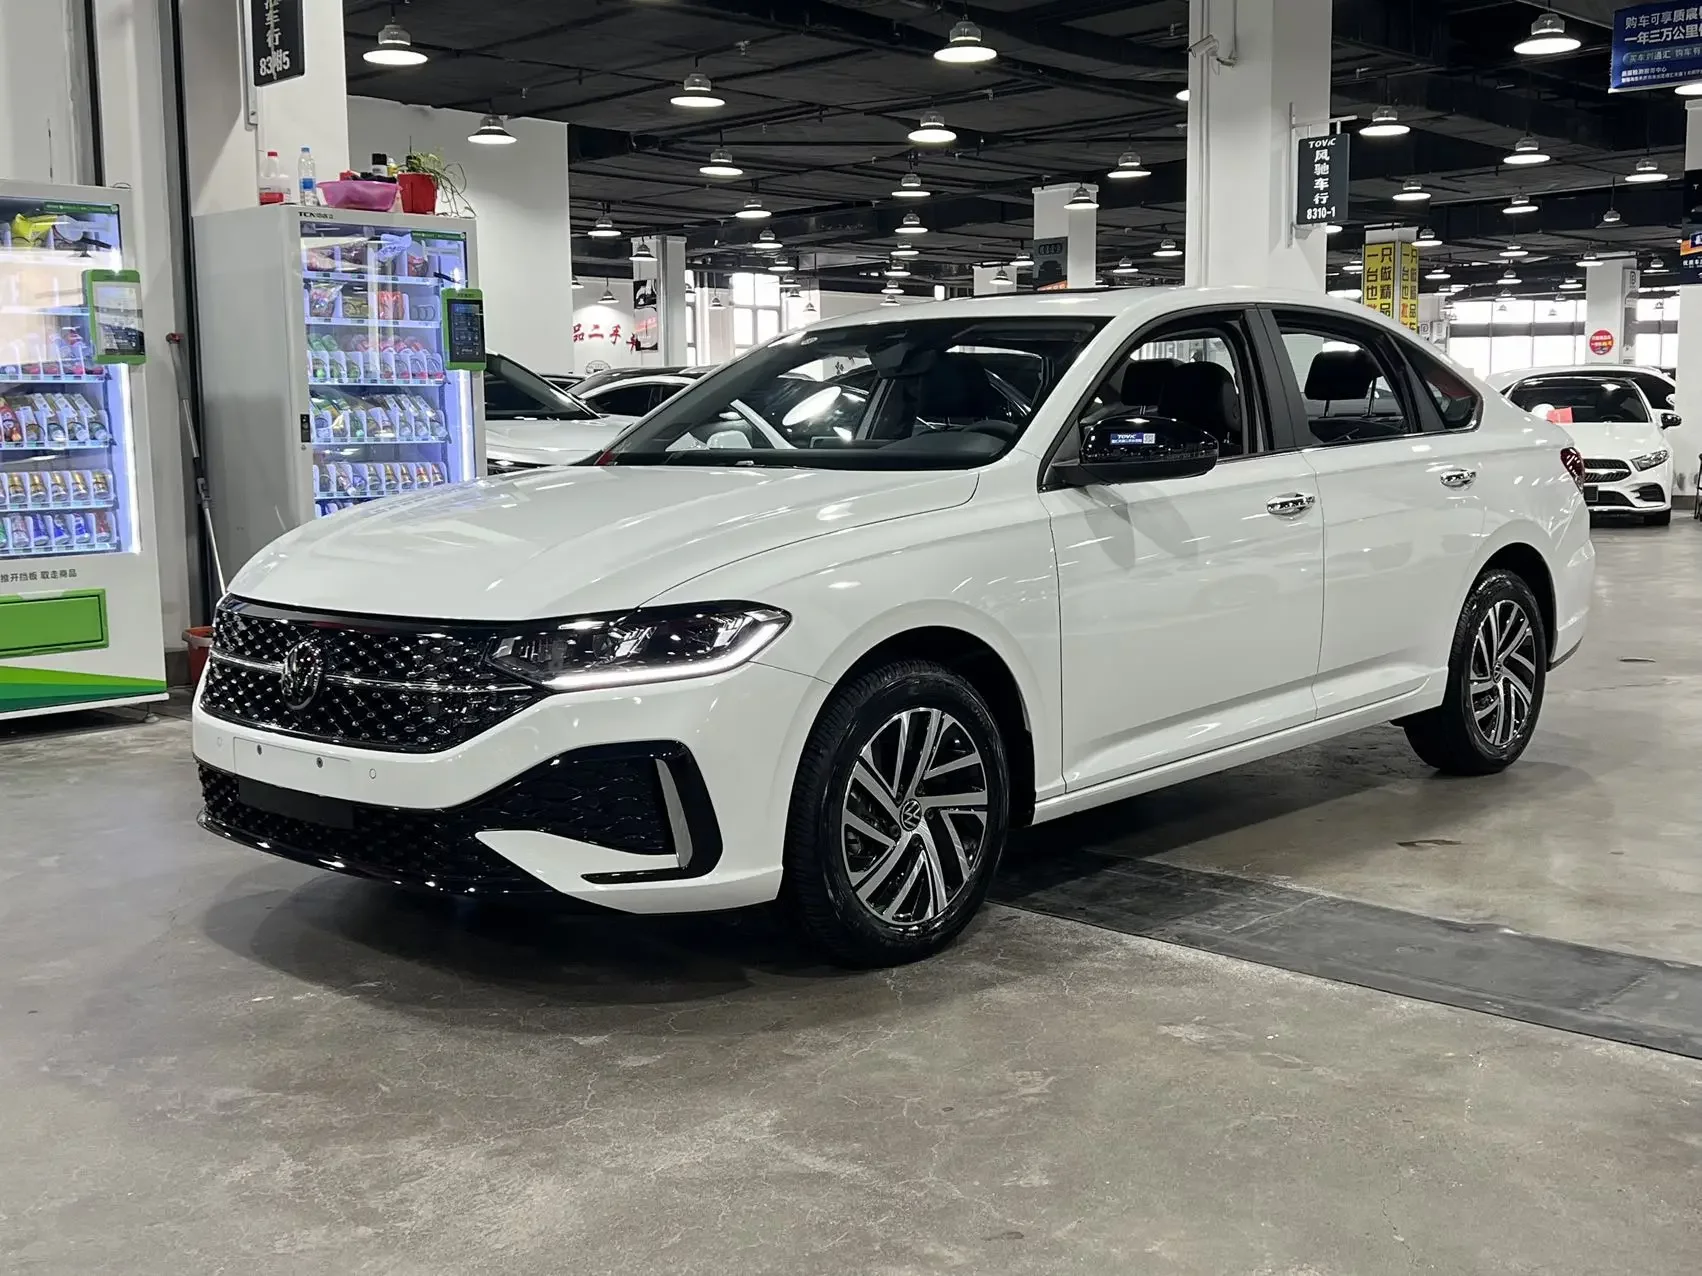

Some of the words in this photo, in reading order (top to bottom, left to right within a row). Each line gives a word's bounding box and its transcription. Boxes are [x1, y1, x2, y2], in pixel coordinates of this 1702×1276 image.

[1624, 24, 1702, 44] 一年三万公里
[1313, 148, 1330, 205] 风驰车行
[1306, 206, 1336, 220] 8310-1
[1366, 253, 1379, 309] 一台也
